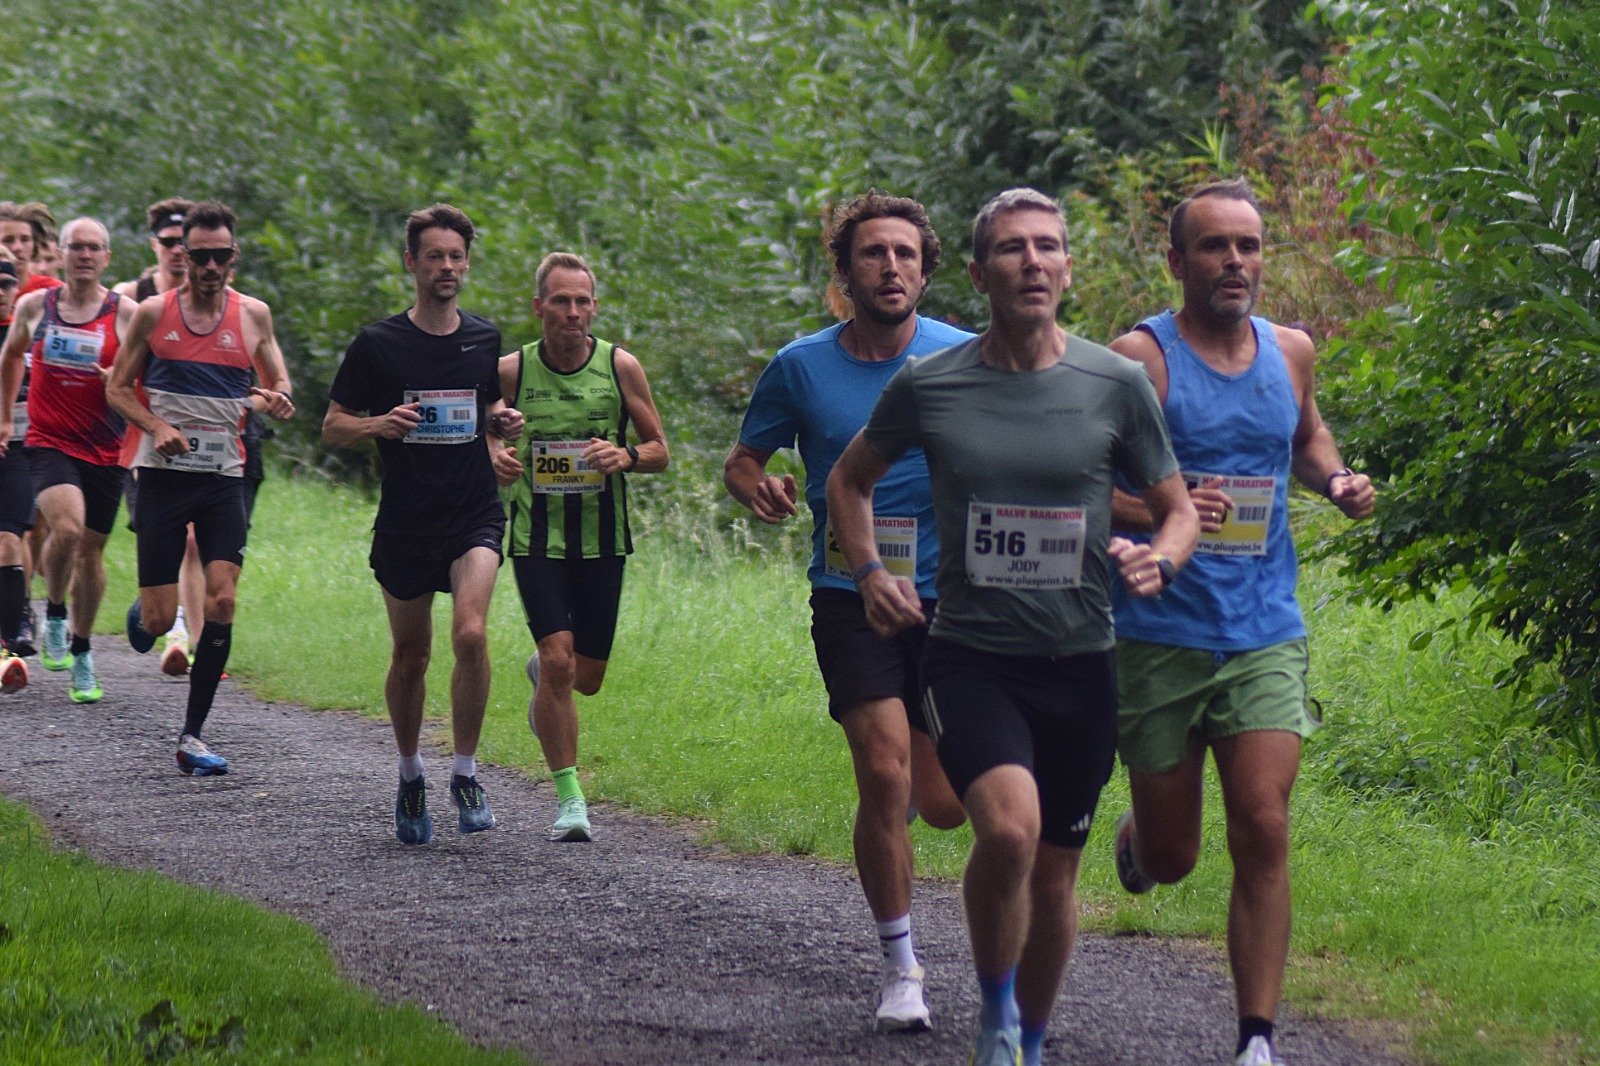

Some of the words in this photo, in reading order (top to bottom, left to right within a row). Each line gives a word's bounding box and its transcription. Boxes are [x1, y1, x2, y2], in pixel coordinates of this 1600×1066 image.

[51, 337, 68, 352] 51
[417, 424, 465, 434] CHRISTOPHE
[188, 437, 200, 452] 9
[536, 456, 570, 474] 206
[552, 474, 585, 483] FRANKY
[1232, 479, 1273, 489] MARATHON
[545, 484, 602, 492] www.plusprint.be
[996, 507, 1026, 519] HALVE
[1029, 509, 1082, 521] MARATHON
[974, 528, 1026, 557] 516
[1007, 559, 1041, 573] JODY
[985, 574, 1074, 587] www.plusprint.be
